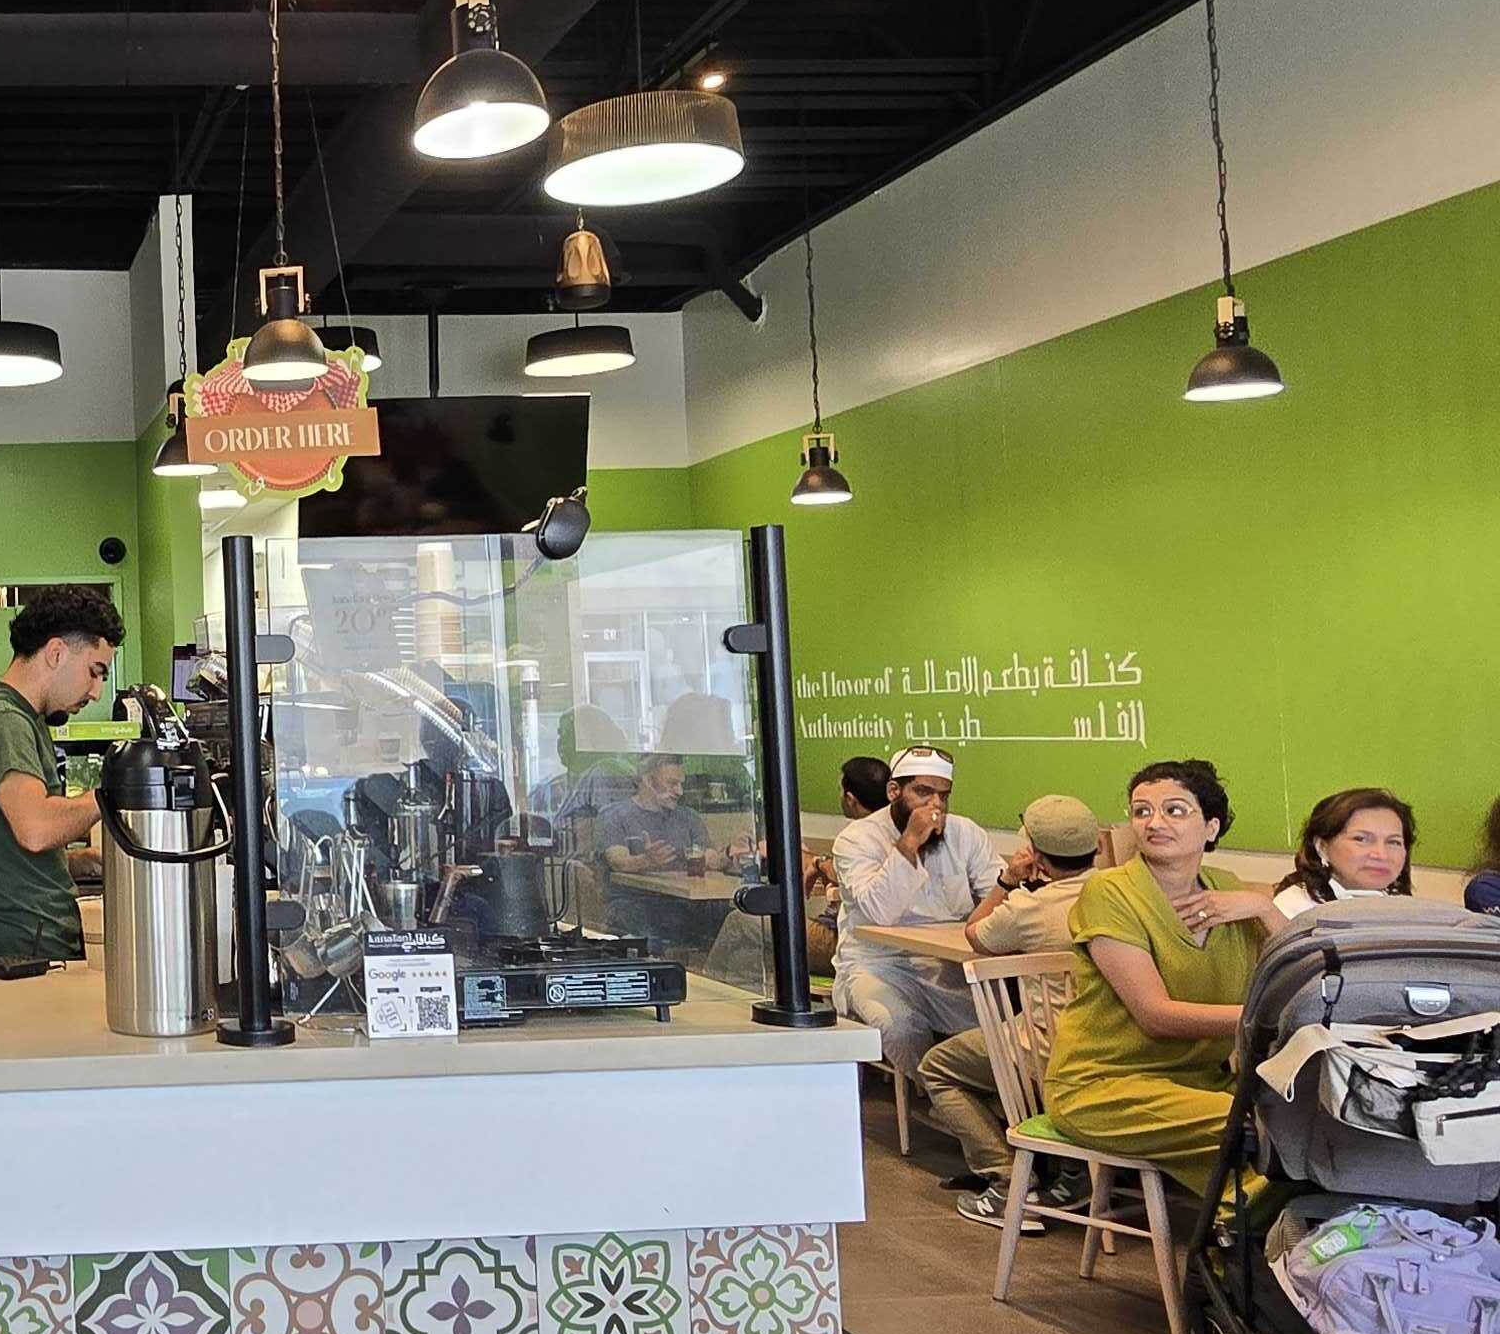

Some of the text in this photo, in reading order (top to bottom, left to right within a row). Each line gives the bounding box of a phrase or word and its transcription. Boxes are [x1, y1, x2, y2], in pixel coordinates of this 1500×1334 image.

[204, 421, 357, 454] ORDER HERE
[796, 673, 820, 699] the
[874, 667, 893, 695] of
[799, 712, 894, 752] Authenticity
[368, 968, 406, 982] Google
